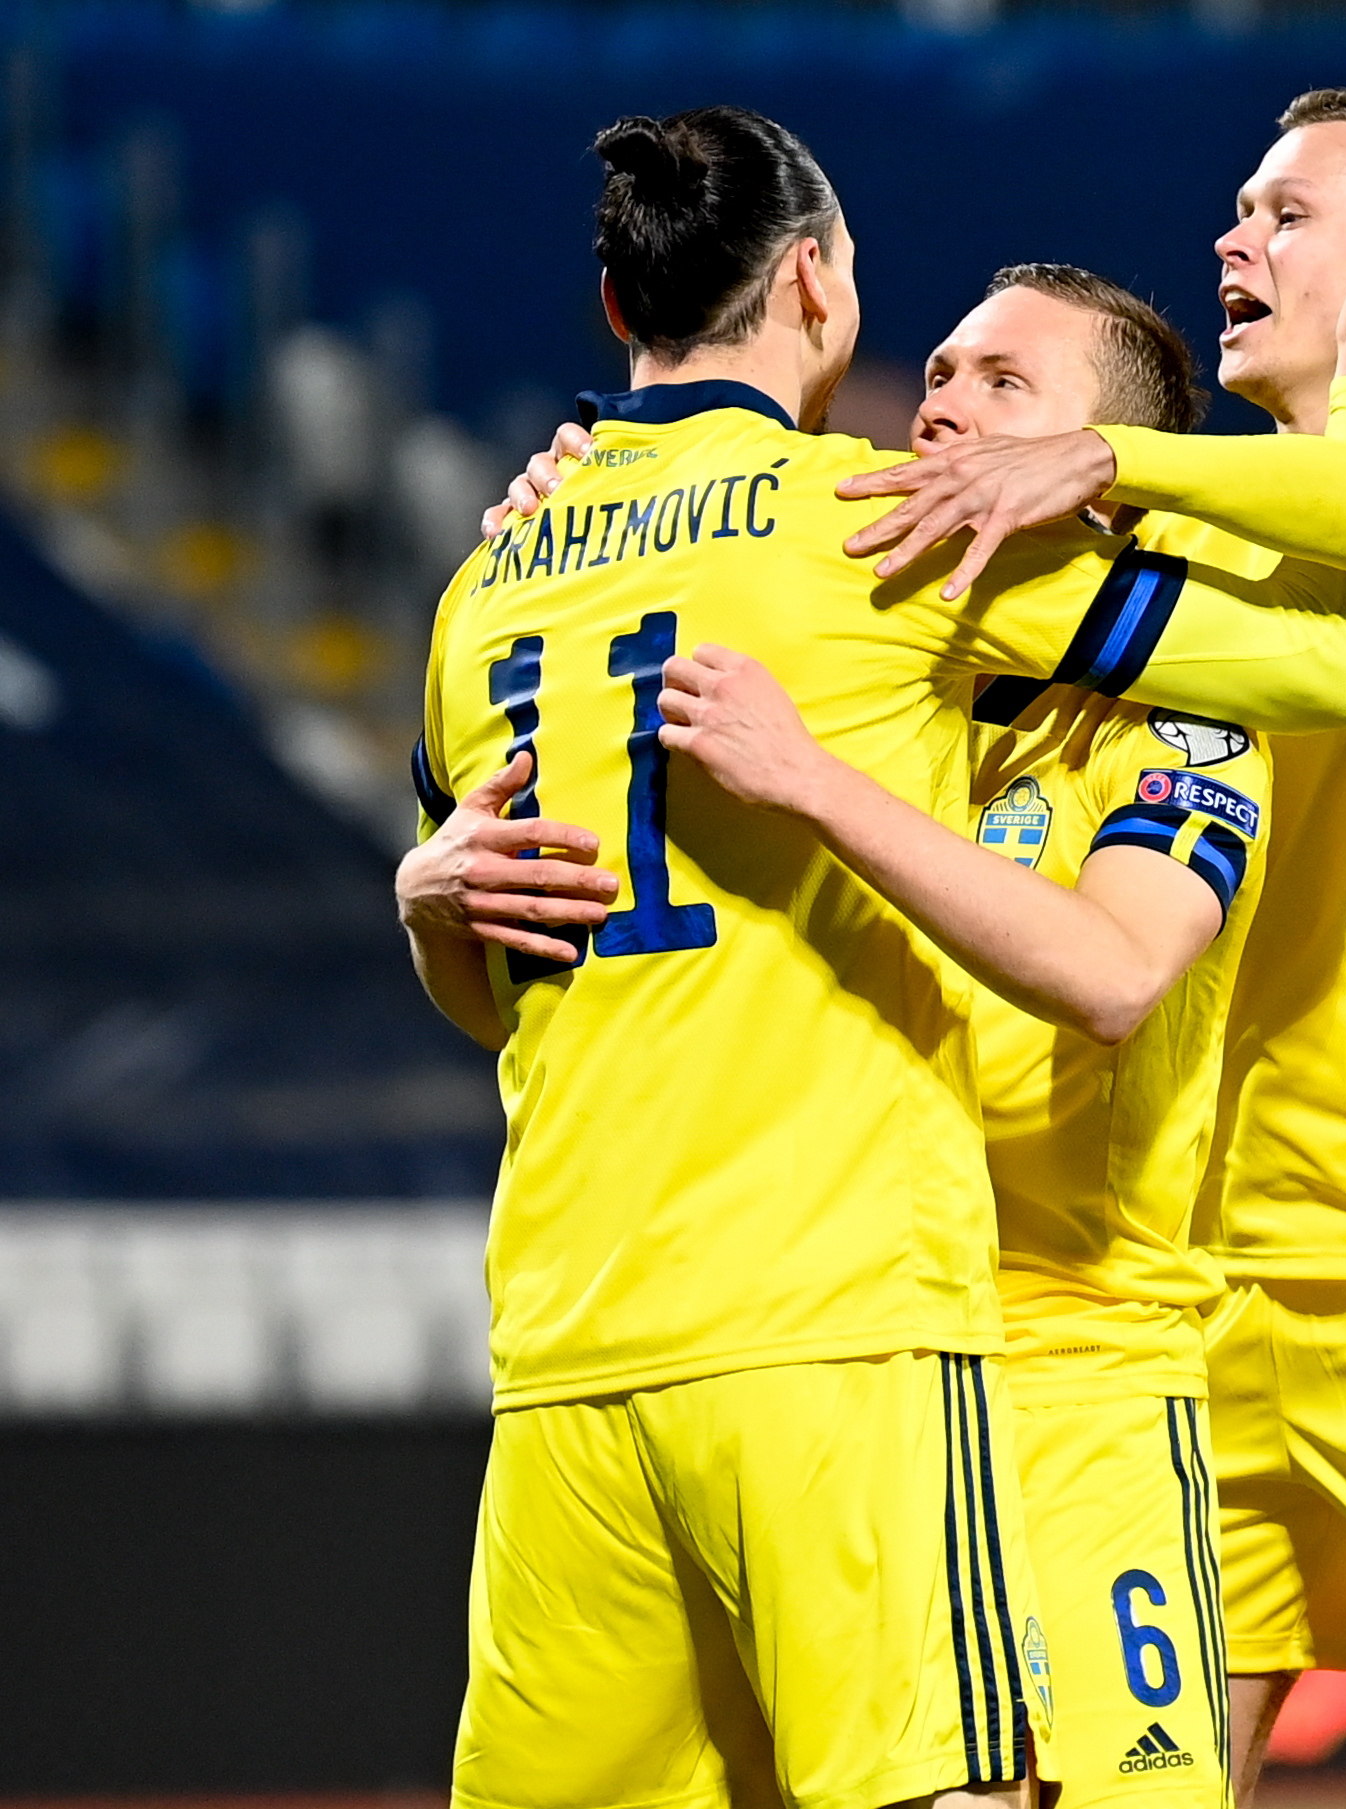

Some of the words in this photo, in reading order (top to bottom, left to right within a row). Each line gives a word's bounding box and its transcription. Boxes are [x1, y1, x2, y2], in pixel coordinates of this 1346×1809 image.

[470, 457, 790, 598] BRAHIMOVIĆ
[488, 610, 718, 985] 11
[992, 815, 1041, 826] SVERIGE
[1174, 782, 1258, 828] RESPECT
[1111, 1568, 1182, 1708] 6
[1119, 1752, 1195, 1774] adidas
